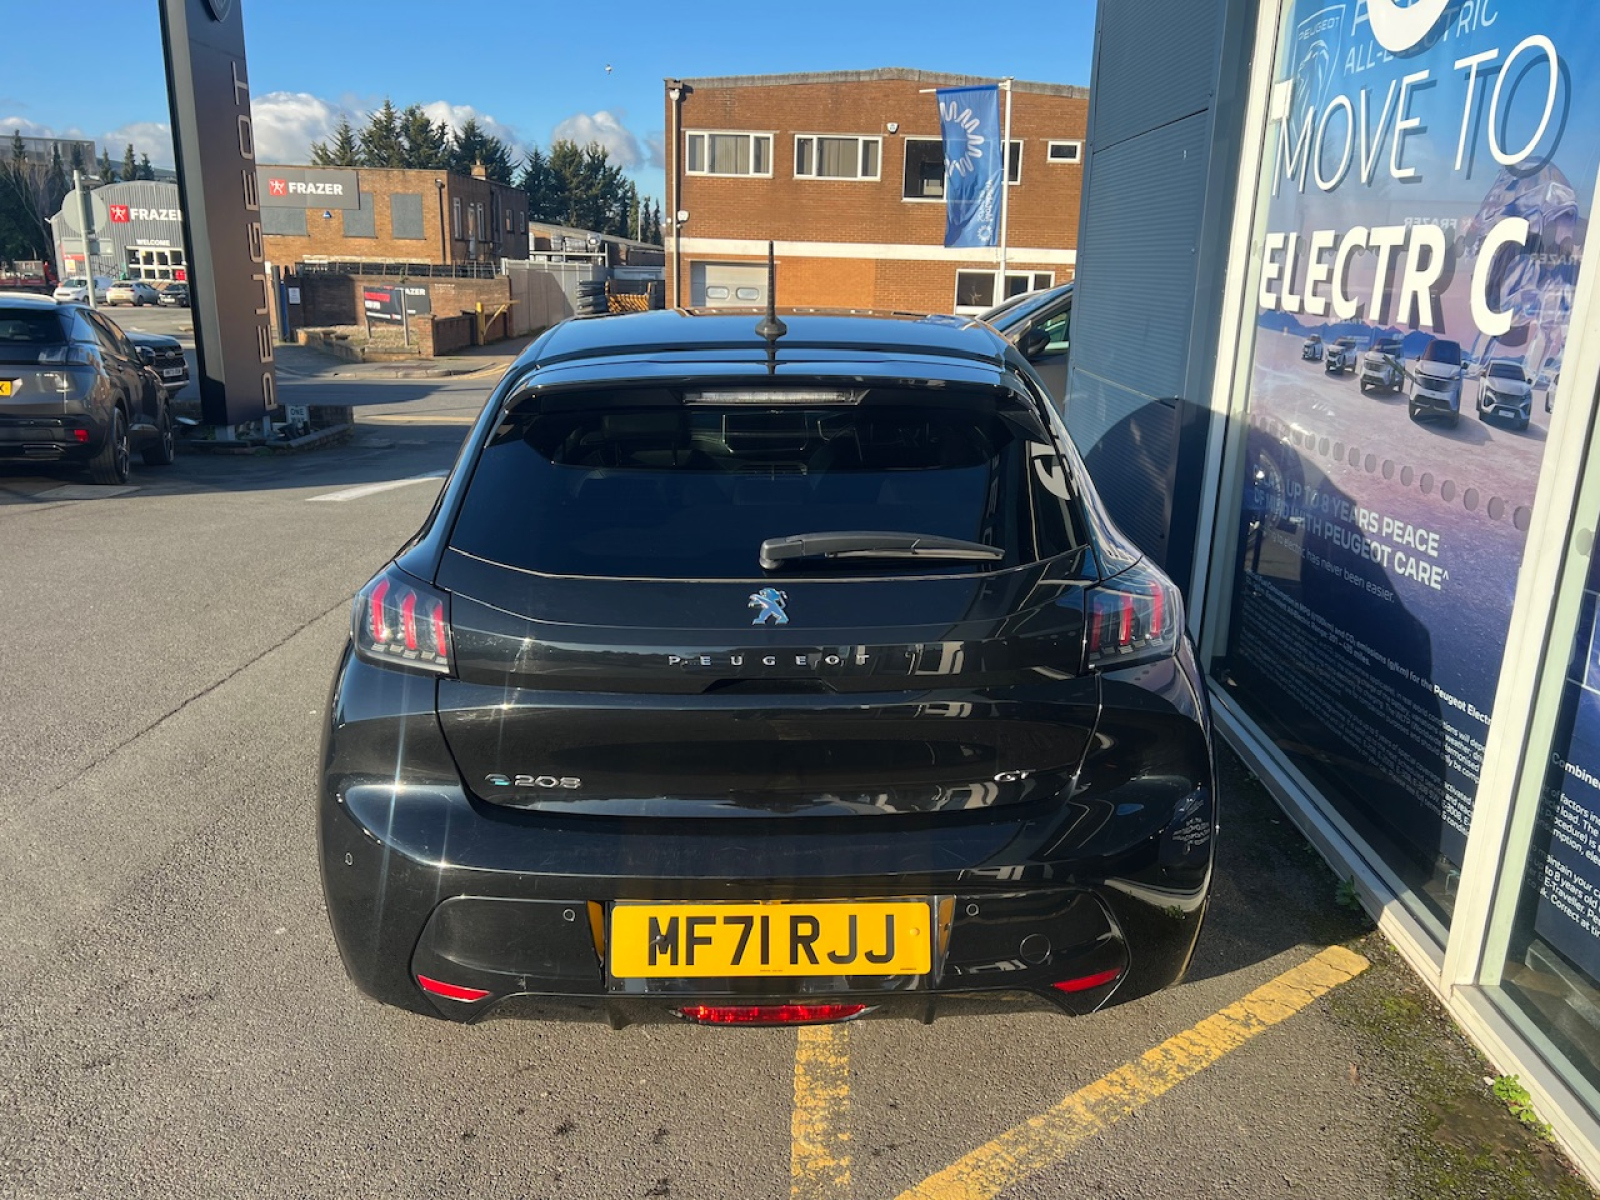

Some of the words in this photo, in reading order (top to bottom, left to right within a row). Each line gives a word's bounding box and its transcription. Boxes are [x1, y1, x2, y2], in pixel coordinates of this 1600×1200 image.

[1298, 16, 1340, 41] PEUGEOT
[1272, 70, 1430, 196] MOVE
[1454, 34, 1559, 171] TO
[288, 182, 344, 195] FRAZER
[230, 60, 279, 412] PEUGEOT
[1286, 479, 1302, 500] UP
[1304, 486, 1319, 508] TO
[1321, 493, 1330, 513] 8
[1332, 498, 1379, 533] YEARS
[1382, 516, 1440, 558] PEACE
[1324, 522, 1391, 568] PEUGEOT
[1307, 549, 1321, 566] has
[1321, 559, 1343, 578] never
[1344, 567, 1365, 589] been
[1365, 581, 1395, 603] easier.
[668, 655, 870, 666] PEUGEOT
[1433, 683, 1467, 714] Peugeot
[994, 769, 1036, 782] GT
[1560, 792, 1589, 818] factors
[1560, 805, 1580, 826] load.
[1583, 819, 1600, 838] The
[1588, 835, 1597, 849] is
[1538, 848, 1573, 880] maintain
[1573, 873, 1593, 893] your
[1544, 864, 1554, 877] to
[1554, 870, 1561, 882] 8
[1560, 877, 1584, 900] years
[1584, 894, 1598, 910] old
[1550, 894, 1580, 924] Correct
[1580, 918, 1590, 931] at
[647, 915, 770, 966] MF71
[789, 914, 895, 966] RJJ
